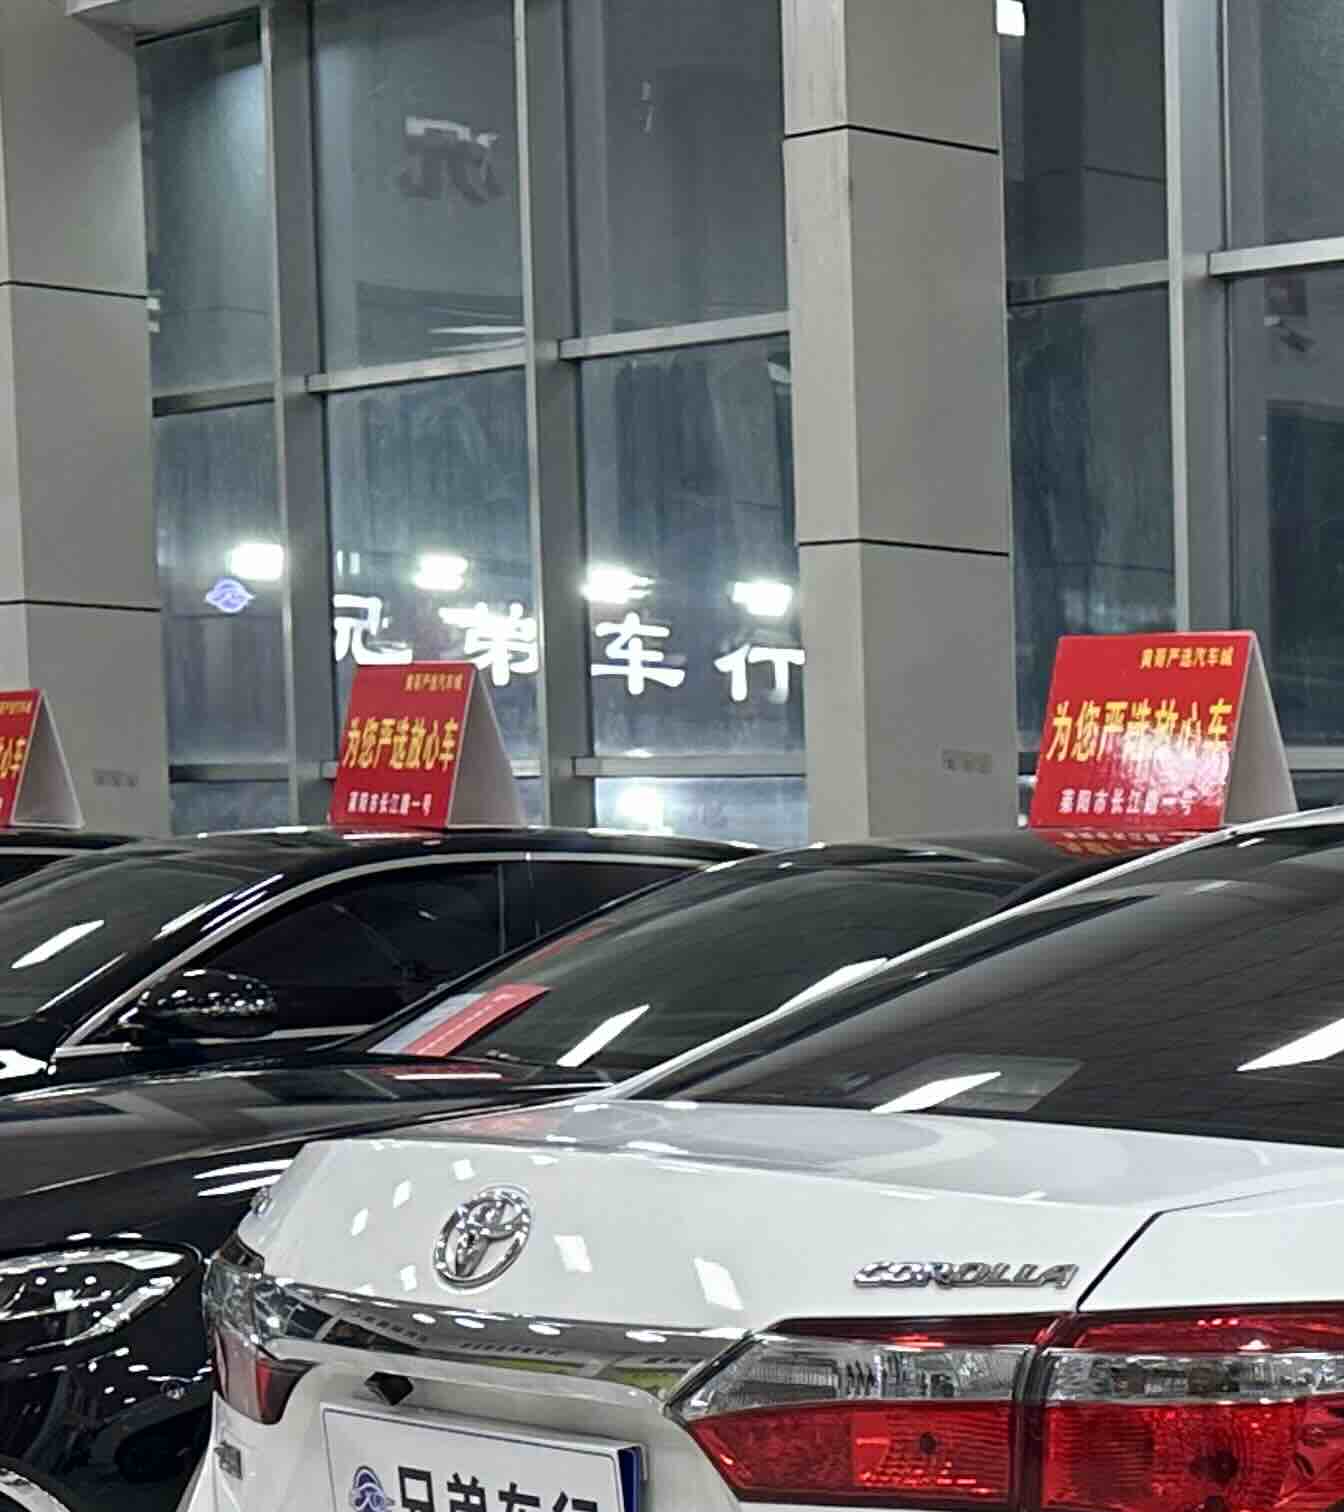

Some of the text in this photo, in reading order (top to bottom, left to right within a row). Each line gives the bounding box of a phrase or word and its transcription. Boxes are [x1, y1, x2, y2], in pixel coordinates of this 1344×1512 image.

[333, 594, 806, 702] 兄弟车行
[342, 716, 459, 772] 为您严选放心车
[1046, 698, 1233, 762] 为您严选放心车
[854, 1261, 1079, 1289] COROLLA
